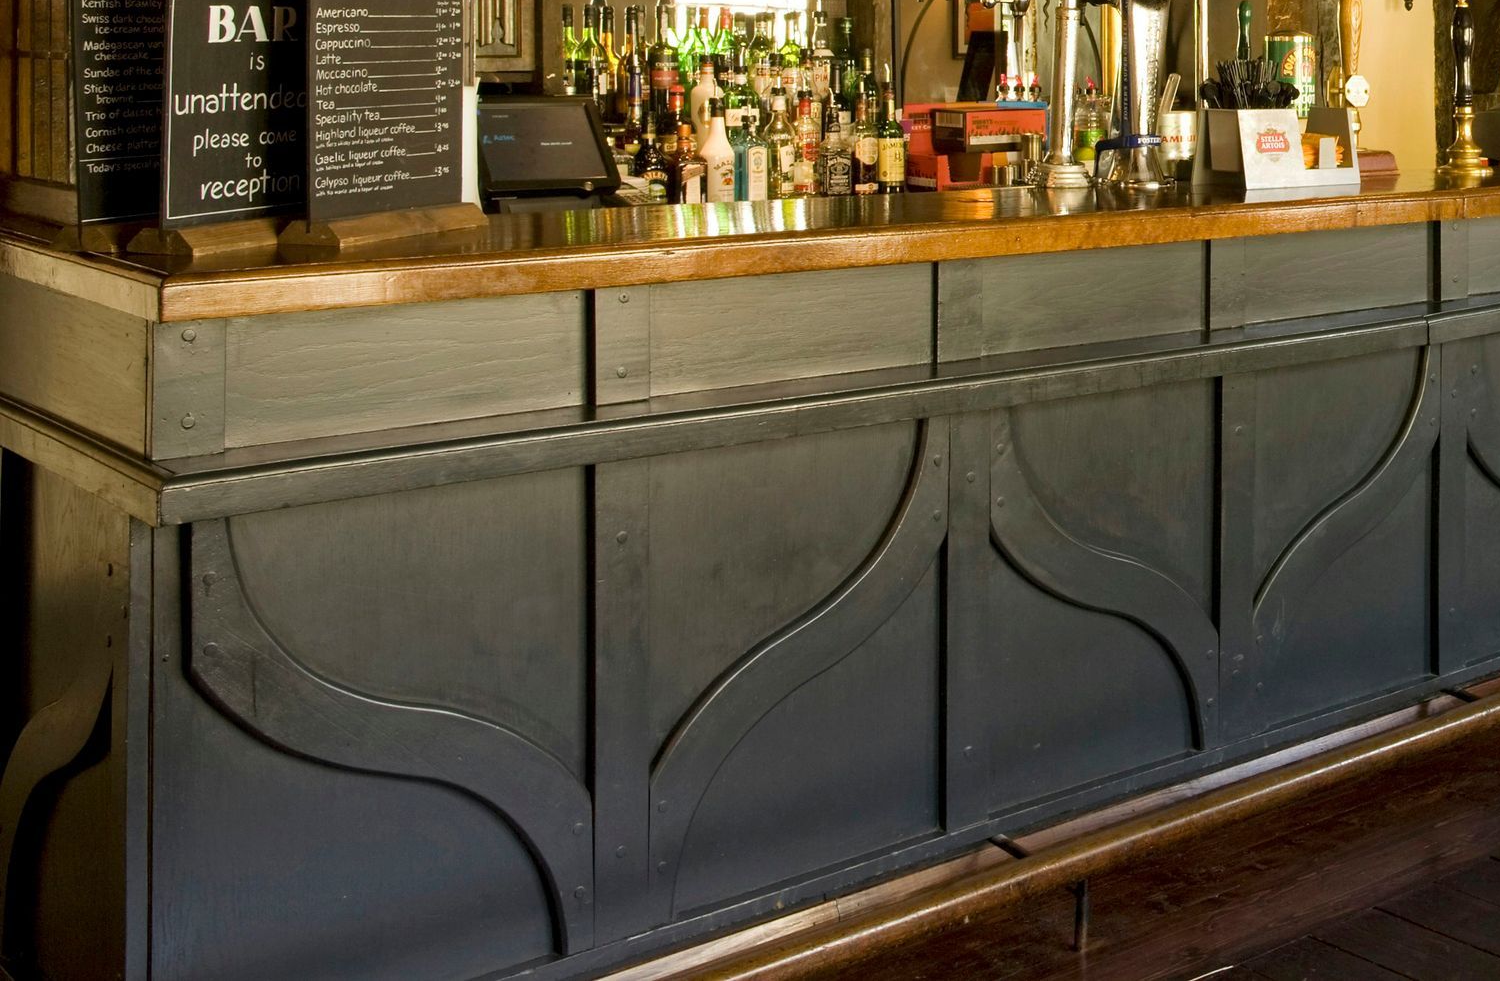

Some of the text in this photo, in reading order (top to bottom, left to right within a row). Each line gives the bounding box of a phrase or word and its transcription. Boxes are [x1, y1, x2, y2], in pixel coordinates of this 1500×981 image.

[82, 13, 110, 24] Swiss
[316, 7, 369, 18] Americano
[208, 4, 299, 43] BAR
[316, 22, 361, 35] Espresso
[83, 40, 145, 53] Madagascan
[315, 37, 371, 53] Cappuccino
[249, 52, 265, 71] is
[316, 54, 341, 65] Latte
[83, 66, 120, 79] Sundae
[316, 69, 368, 81] Moccacino
[83, 84, 114, 95] Sticky
[316, 81, 378, 96] Hot chocolate
[316, 100, 335, 110] Tea
[85, 111, 107, 121] Trio
[315, 109, 380, 126] Speciality tea
[85, 126, 124, 138] Cornish
[315, 127, 356, 144] Highland
[358, 126, 389, 138] liqueur
[390, 123, 416, 134] coffee
[193, 128, 297, 157] please come
[1261, 135, 1284, 143] STELLA
[86, 142, 123, 154] Cheese
[245, 152, 262, 168] to
[315, 152, 345, 165] Gaelic
[349, 150, 379, 163] liqueur
[380, 146, 406, 158] coffee
[201, 168, 300, 202] reception
[315, 177, 349, 189] Calypso
[352, 174, 383, 187] liqueur
[384, 170, 410, 182] coffee
